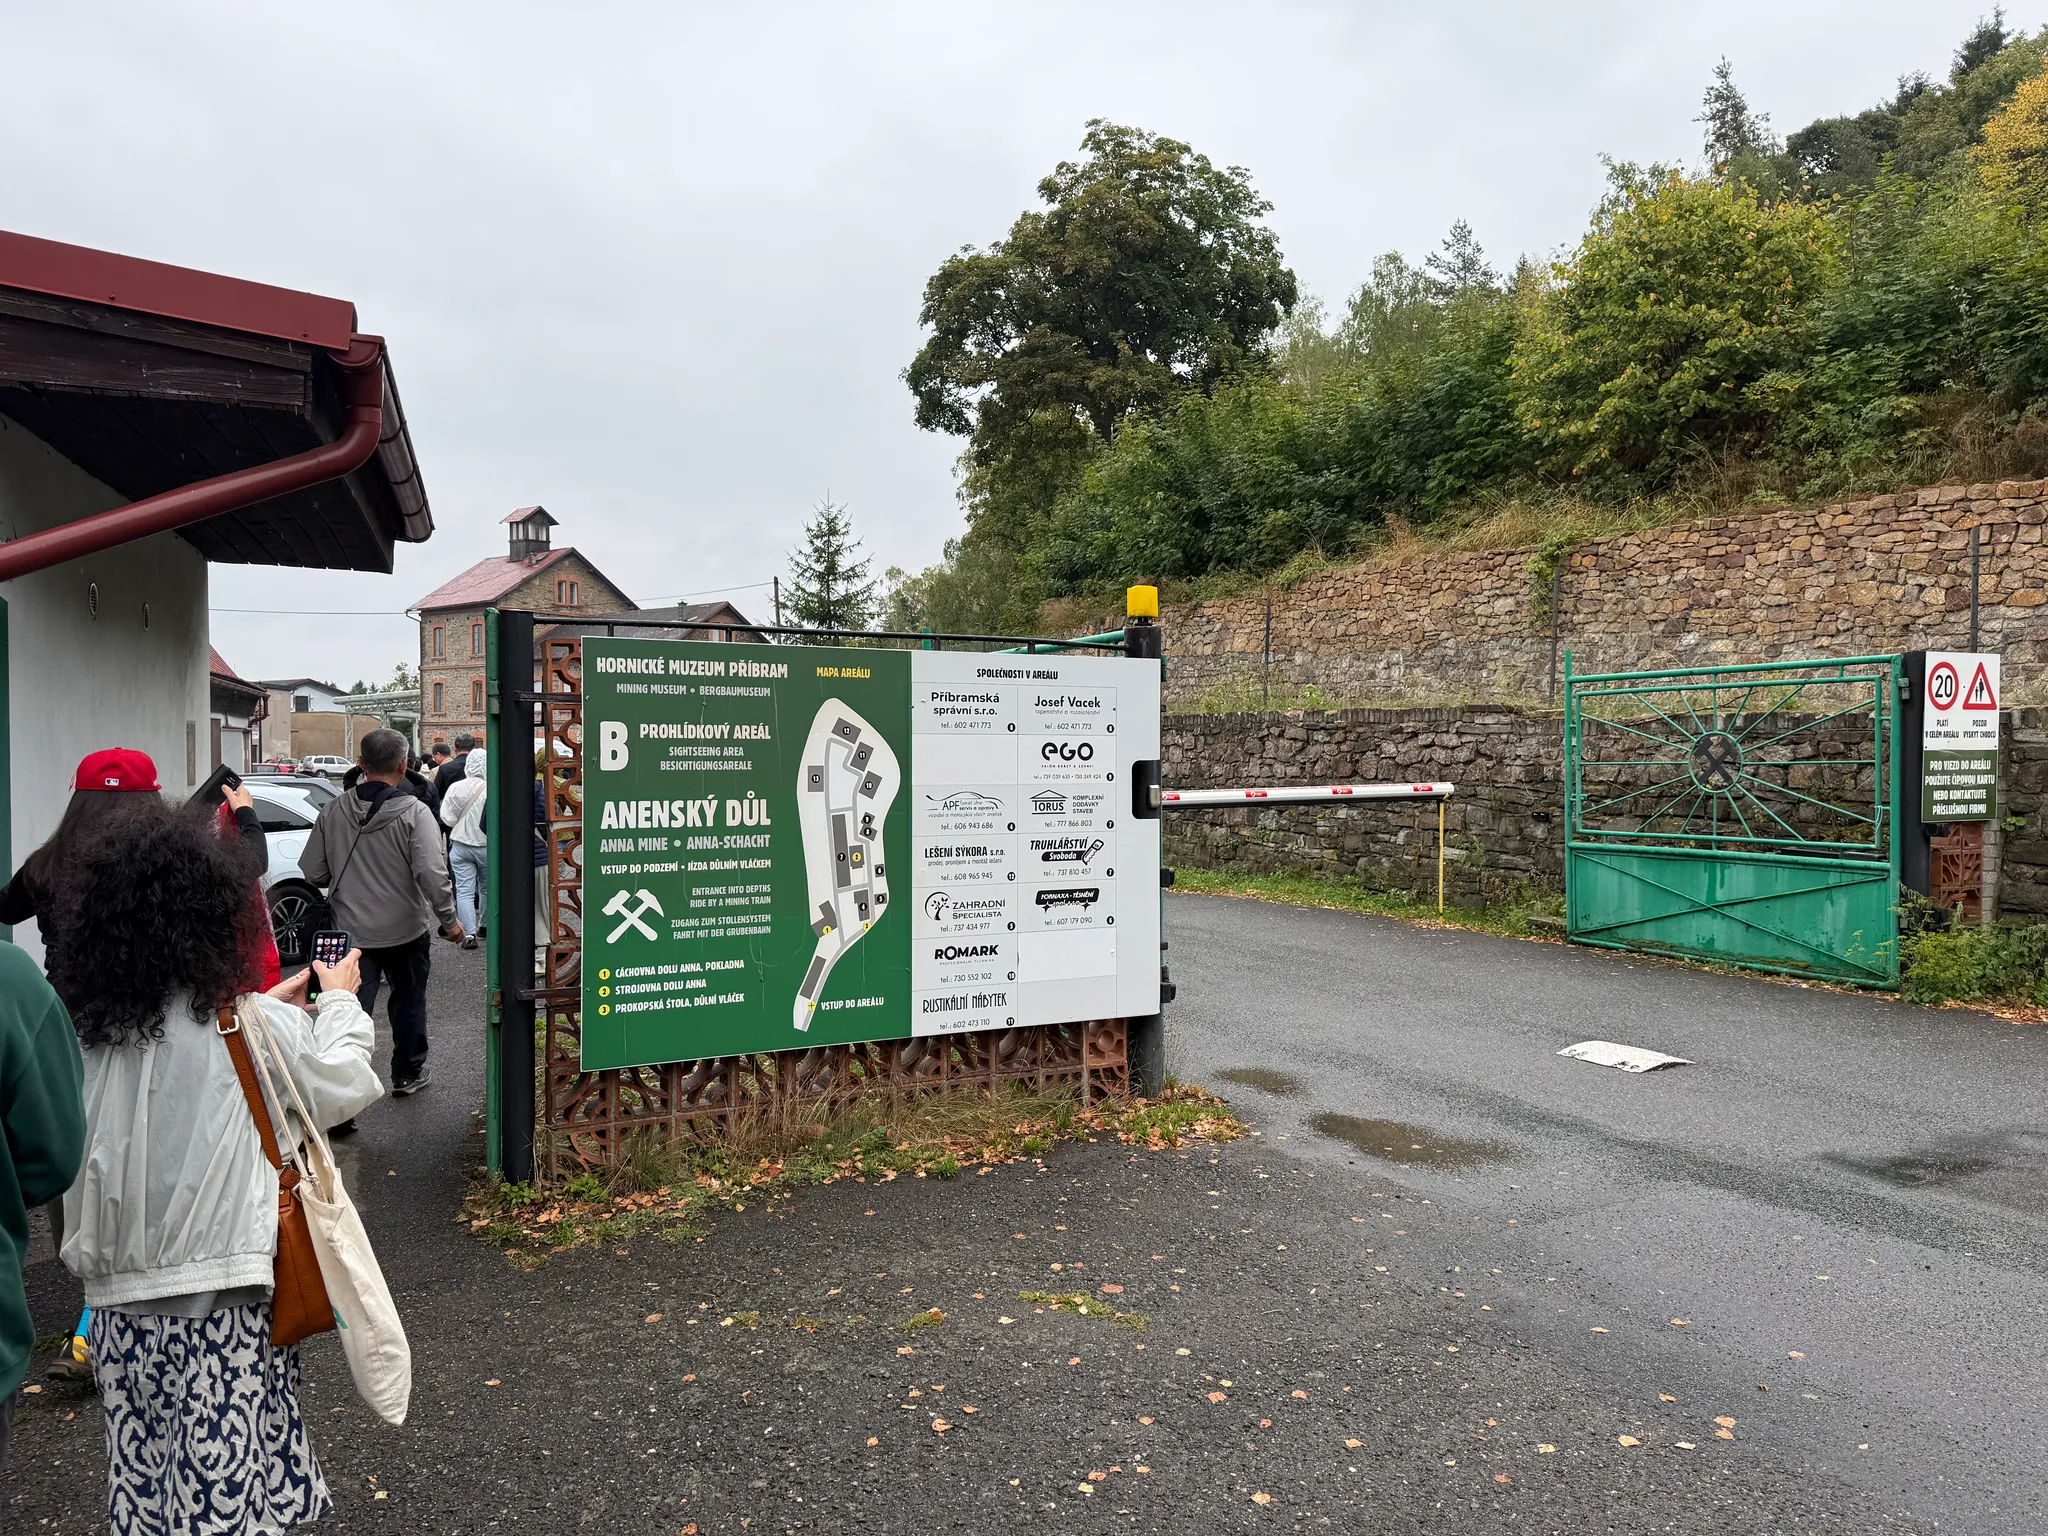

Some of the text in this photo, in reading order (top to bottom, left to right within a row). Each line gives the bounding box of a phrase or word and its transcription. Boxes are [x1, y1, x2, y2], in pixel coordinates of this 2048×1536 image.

[597, 657, 788, 678] HORNICKÉ MUZEUM PŘÍBRAM
[817, 666, 871, 678] MAPA AREÁLU
[976, 668, 1058, 680] SPOLEČNOSTI V AREÁLU
[616, 683, 771, 697] MINING MUSEUM BERGBAUMUSEUM
[1935, 675, 1952, 698] 20
[931, 691, 1000, 703] Příbramská
[1035, 695, 1100, 708] Josef Vacek
[933, 706, 972, 716] správní
[1937, 718, 1949, 726] PLATÍ
[640, 722, 771, 740] PROHLÍDKOVÝ AREÁL
[1943, 730, 1959, 738] AREÁLU
[1963, 730, 1979, 738] VÝSKYT
[600, 721, 629, 771] B
[669, 746, 744, 757] SIGHTSEEING AREA
[660, 760, 752, 771] BESICHTIGUNGSAREALE
[1930, 760, 1991, 770] PRO VJEZD DO AREÁLU
[1952, 774, 1975, 784] ČIPOVOU
[1977, 775, 1995, 784] KARTU
[1933, 790, 1948, 800] NEBO
[600, 790, 771, 830] ANENSKÝ DŮL
[942, 801, 960, 811] APF
[1932, 803, 1986, 815] PŘÍSLUŠNOU FIRMU
[599, 834, 771, 853] ANNA MINE ANNA-SCHACHT
[1030, 836, 1089, 851] TRUHLÁŘSTVÍ
[925, 845, 953, 858] LEŠENÍ
[955, 845, 988, 857] SÝKORA
[1049, 852, 1076, 860] Svoboda
[601, 858, 771, 875] VSTUP DO PODZEMÍ JÍZDA DŮLNÍM VLÁČKEM
[692, 884, 771, 896] ENTRANCE INTO DEPTHS
[690, 896, 771, 908] RIDE BY A MINING TRAIN
[952, 898, 1006, 910] ZAHRADNÍ
[671, 914, 771, 928] ZUGANG ZUM STOLLENSYSTEM
[952, 911, 1002, 919] SPECIALISTA
[673, 925, 771, 940] FAHRT MIT DER GRUBENBAHN
[934, 944, 999, 960] ROMARK
[615, 965, 656, 978] CÁCHOVNA
[658, 965, 678, 975] DOLU
[680, 963, 703, 975] ANNA,
[705, 960, 744, 972] POKLADNA
[615, 982, 661, 995] STROJOVNA
[664, 981, 683, 992] DOLU
[685, 979, 707, 991] ANNA
[615, 1000, 664, 1014] PROKOPSKÁ
[666, 998, 692, 1011] ŠTOLA,
[694, 995, 716, 1008] DŮLNÍ
[718, 993, 745, 1006] VLÁČEK
[821, 997, 884, 1011] VSTUP DO AREÁLU
[923, 992, 1007, 1013] RUSTIKÁLNÍ NÁBYTEK
